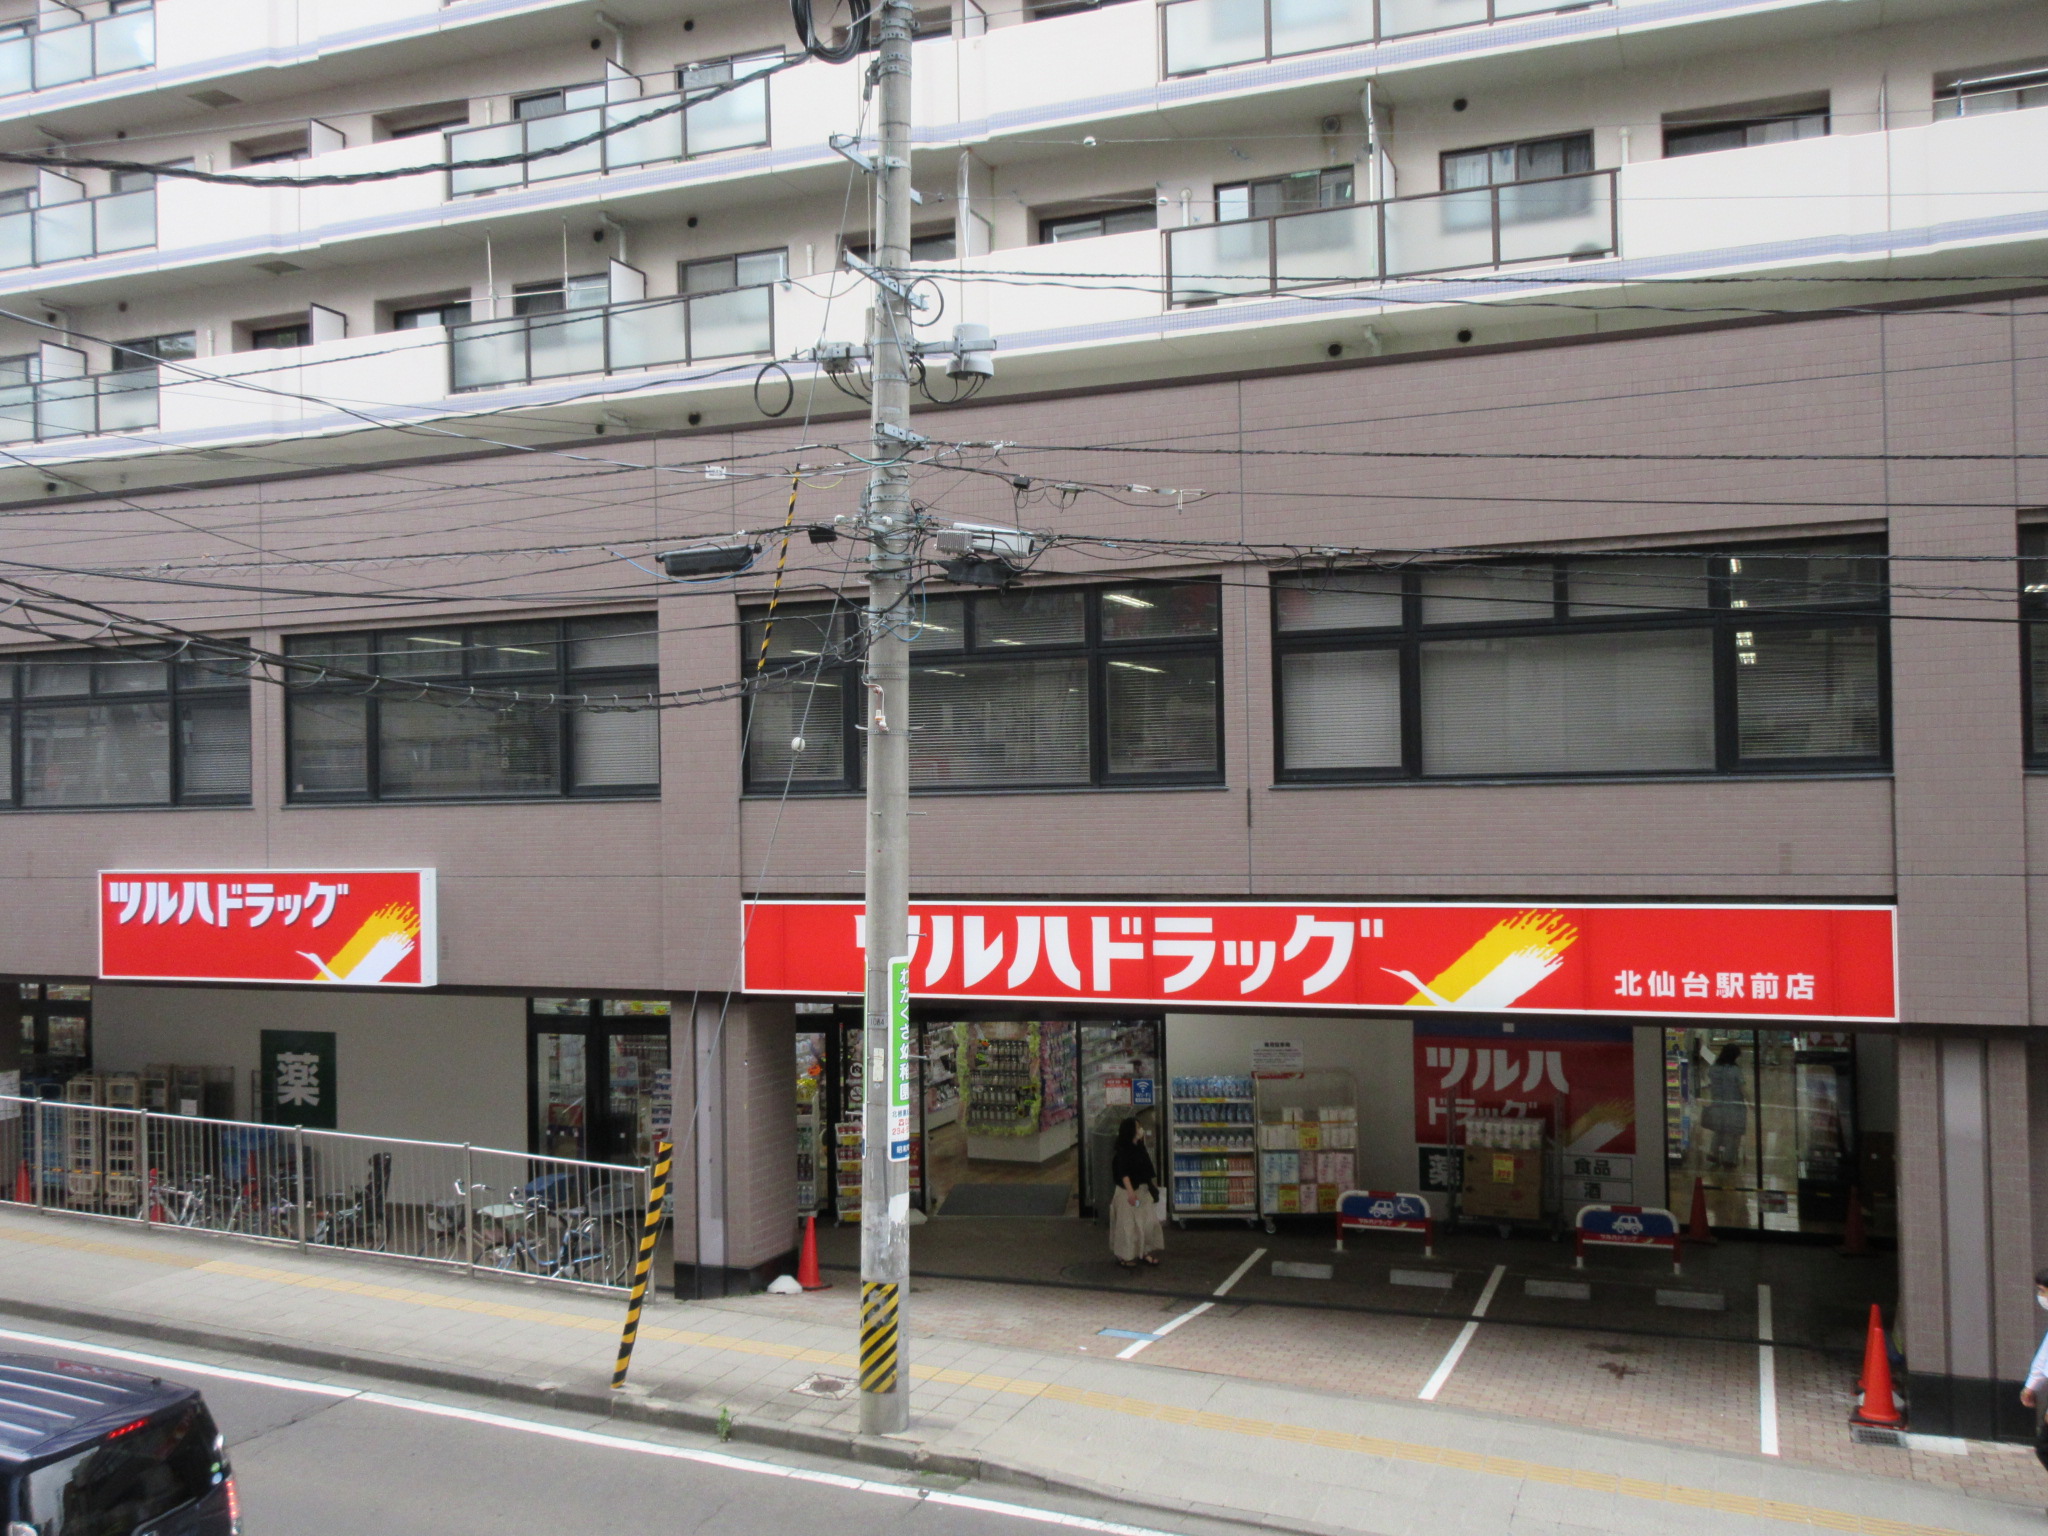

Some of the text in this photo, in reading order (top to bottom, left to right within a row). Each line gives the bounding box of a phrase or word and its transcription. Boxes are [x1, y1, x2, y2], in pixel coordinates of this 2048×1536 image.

[109, 881, 349, 928] ツルハドラッグ
[1614, 969, 1816, 1001] 北仙台駅前店
[276, 1051, 320, 1106] 薬
[1425, 1046, 1570, 1095] ツルハ
[1573, 1157, 1611, 1176] 食品
